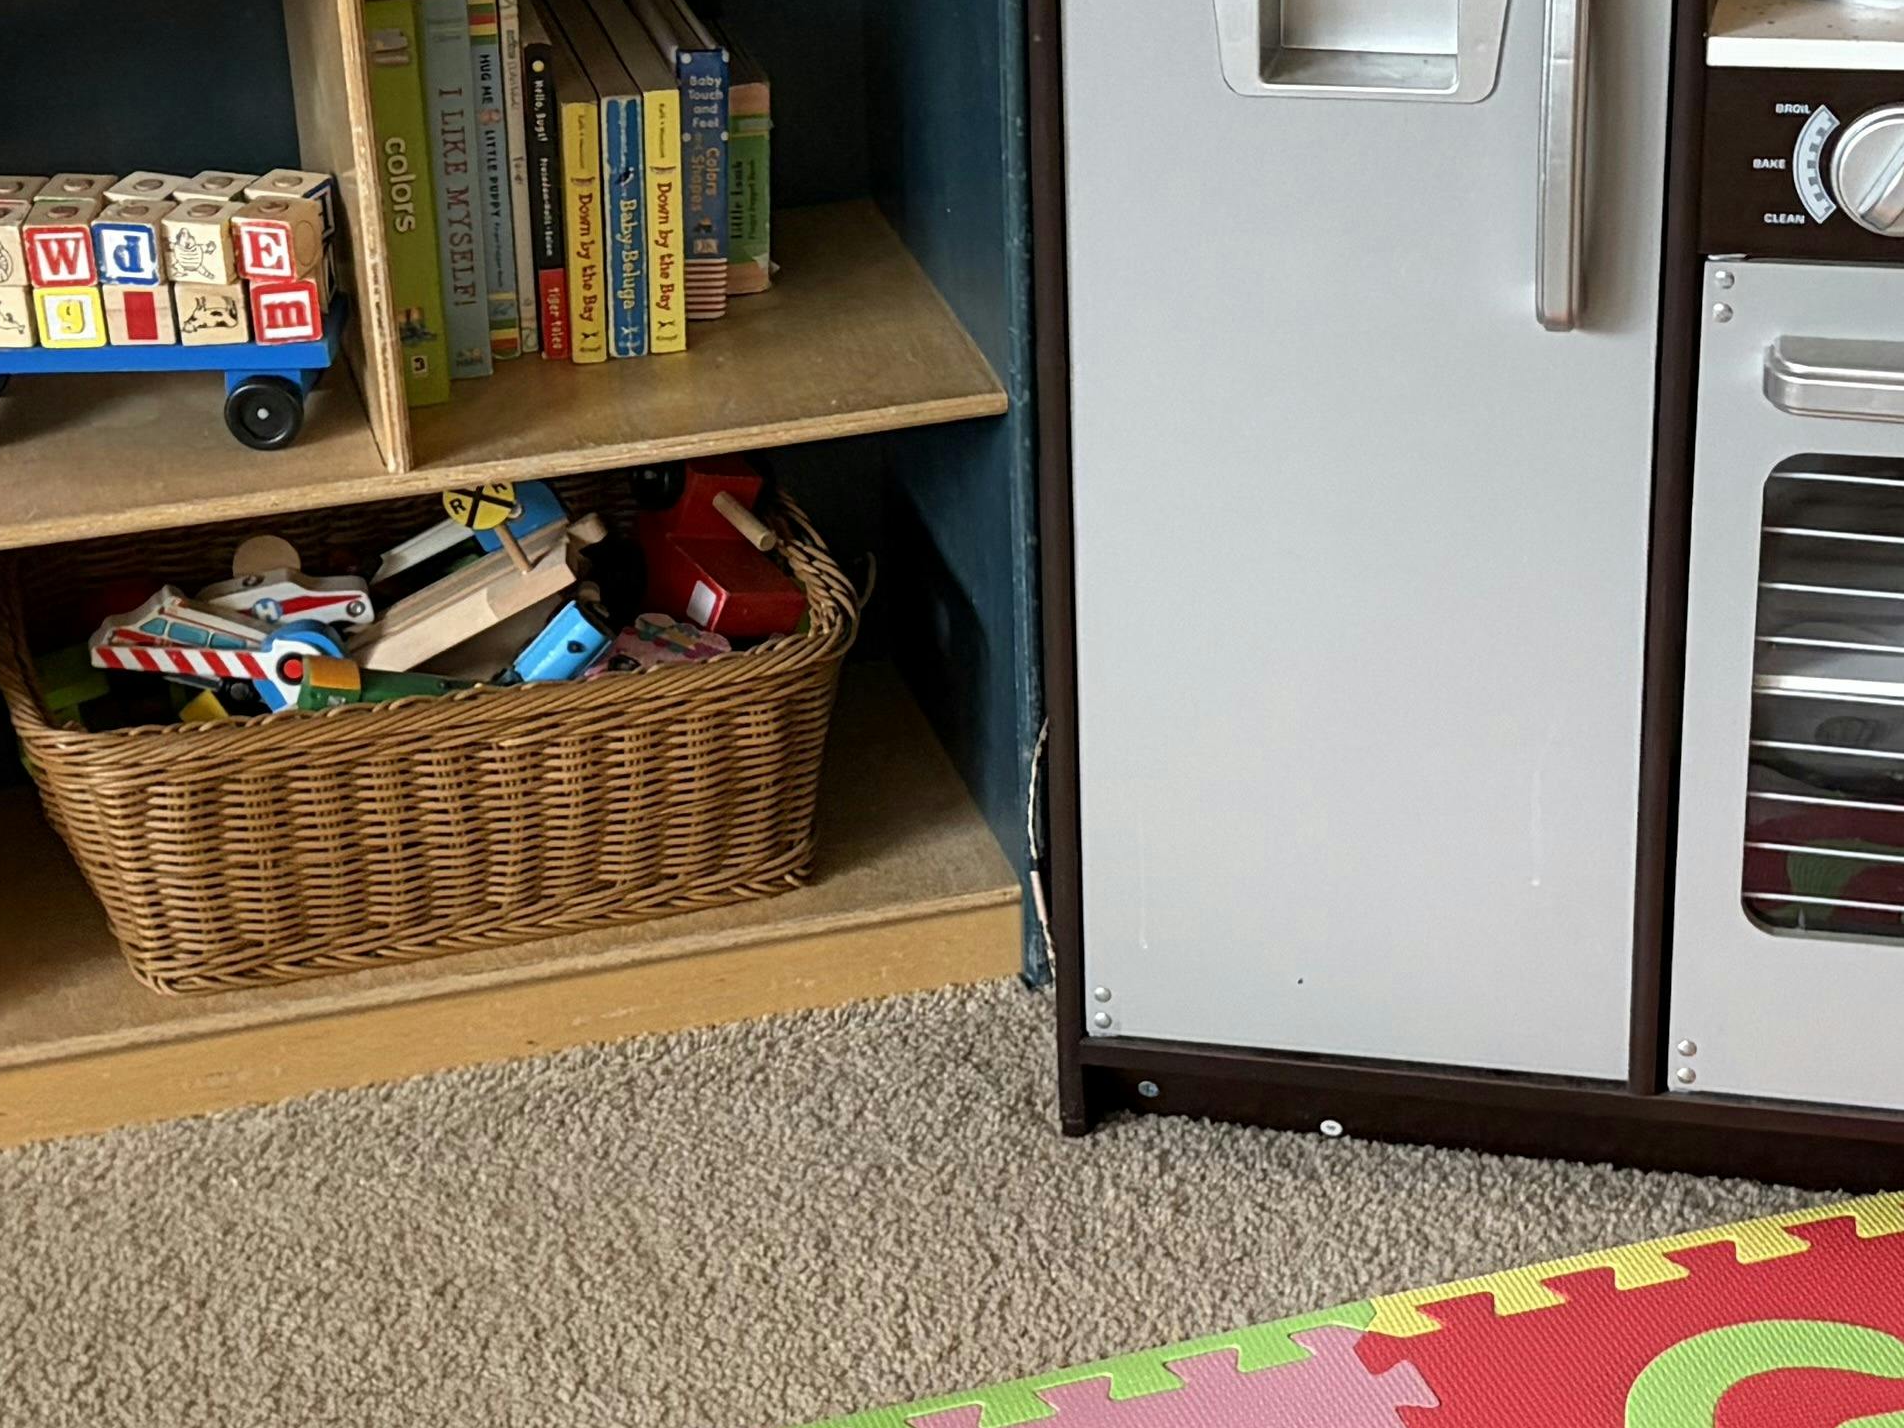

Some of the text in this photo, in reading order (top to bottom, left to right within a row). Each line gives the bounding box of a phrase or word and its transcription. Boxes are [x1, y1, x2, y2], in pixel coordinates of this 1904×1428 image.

[480, 54, 492, 81] HUG
[690, 75, 722, 88] Baby
[481, 86, 493, 104] ME
[689, 89, 723, 101] Touch
[693, 104, 718, 114] and
[1775, 103, 1811, 115] BROIL
[692, 117, 719, 128] Feel
[484, 130, 498, 172] LITTLE
[1752, 158, 1786, 169] BAKE
[384, 136, 417, 233] colors
[690, 155, 705, 212] Shapes
[705, 147, 720, 197] Colors
[439, 88, 478, 306] I LIKE MYSELF!
[489, 176, 502, 218] PUPPY
[1764, 212, 1805, 224] CLEAN
[37, 236, 81, 275] W
[113, 235, 144, 272] d
[247, 231, 283, 270] E
[576, 193, 598, 322] Down by the Bay
[615, 199, 641, 310] Baby Beluga
[654, 182, 675, 311] Down by the Bay
[264, 301, 309, 329] m
[449, 498, 467, 515] R
